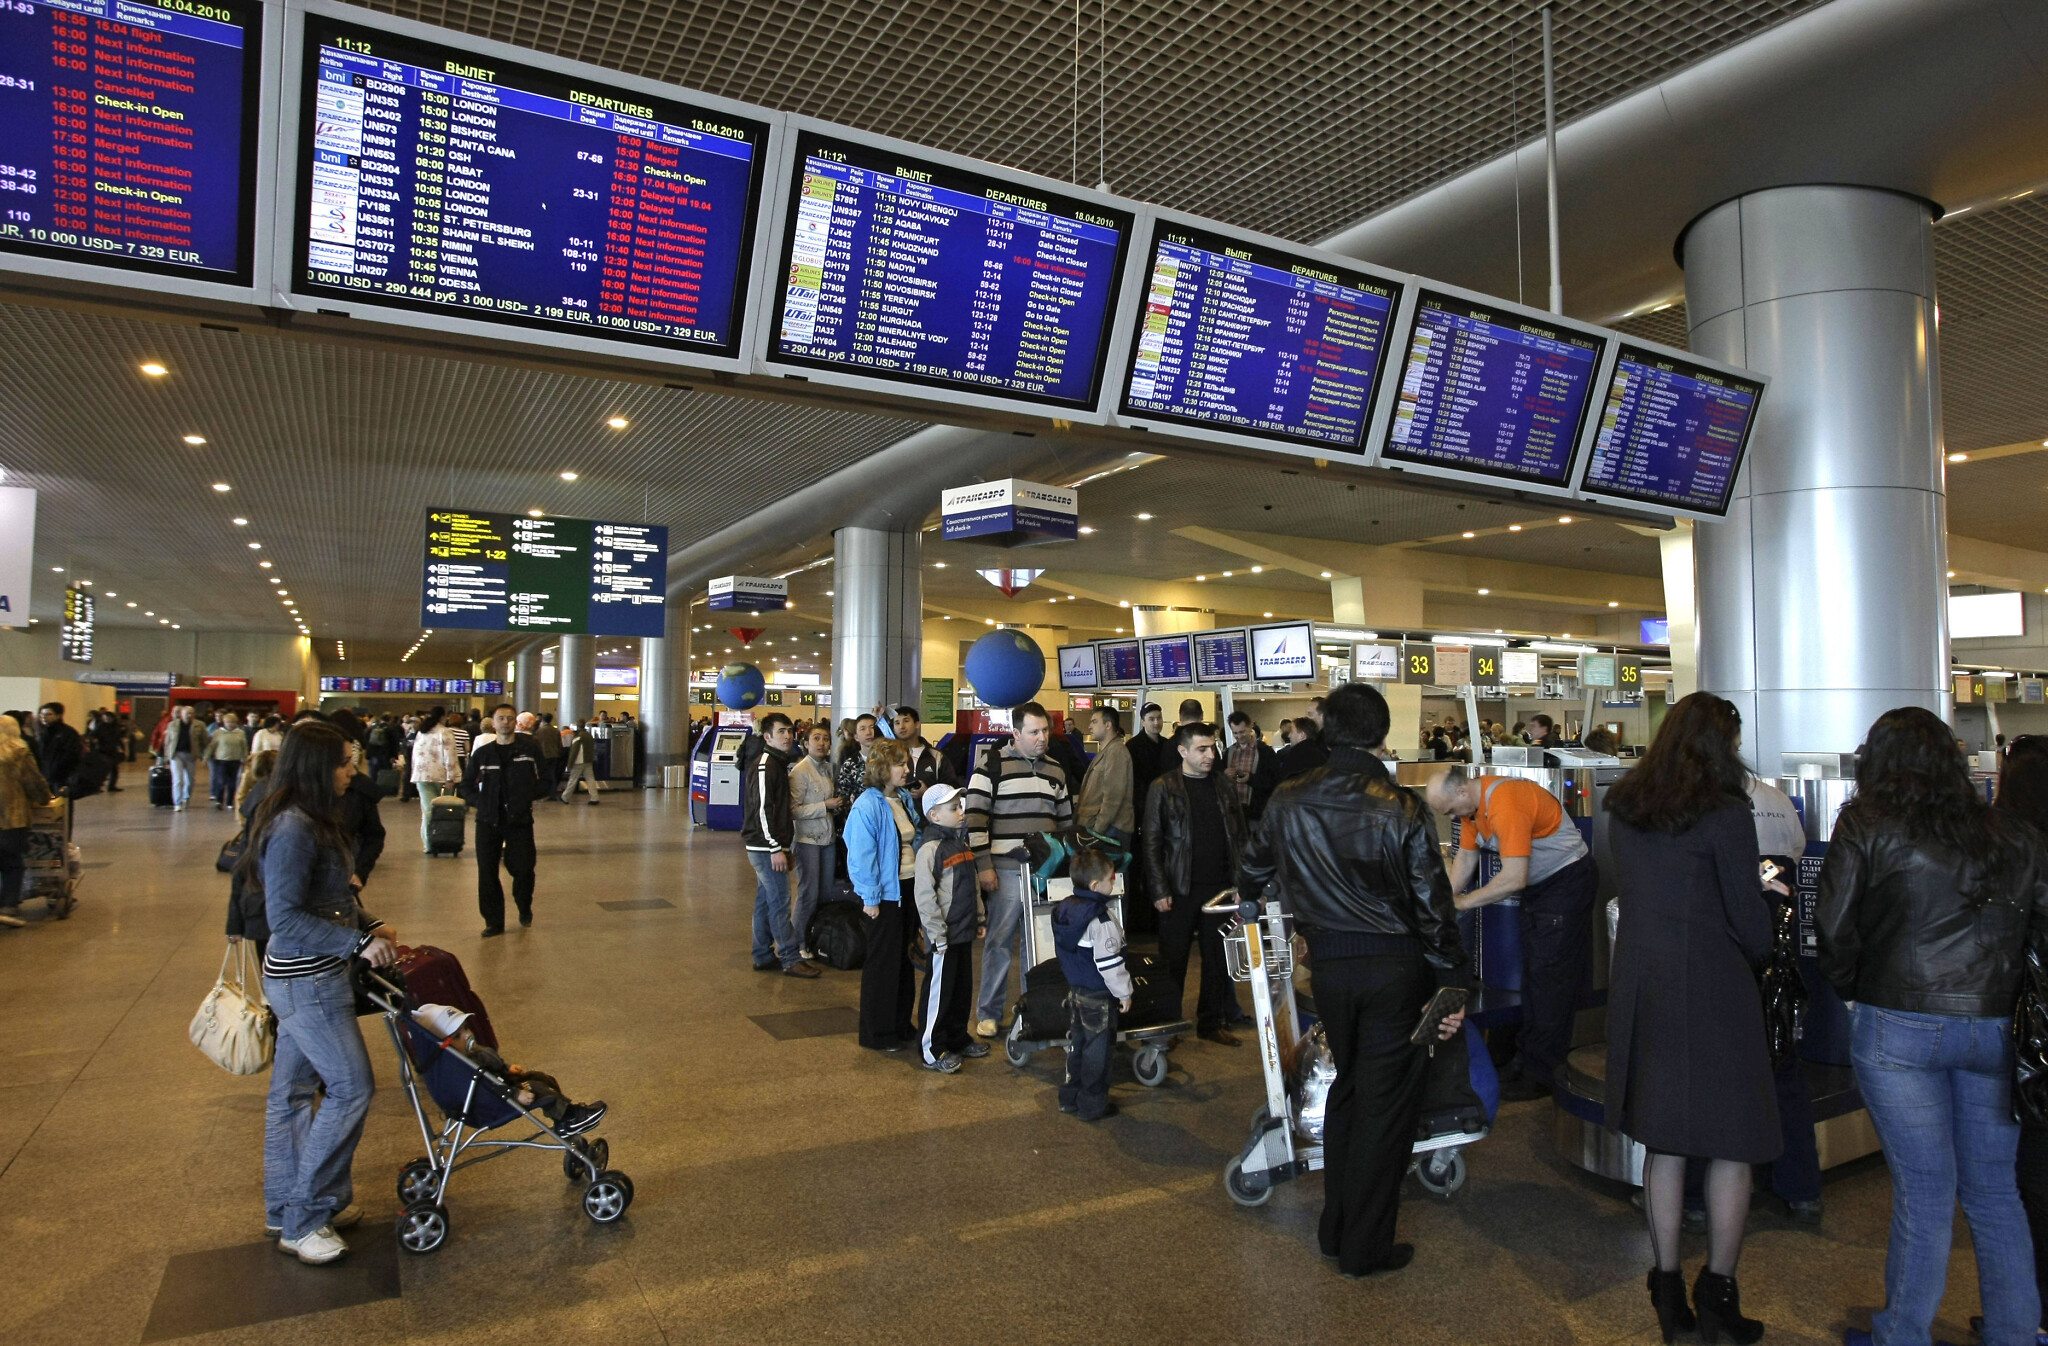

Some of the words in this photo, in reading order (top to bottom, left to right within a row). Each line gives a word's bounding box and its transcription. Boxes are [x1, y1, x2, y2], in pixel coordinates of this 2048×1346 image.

[51, 10, 87, 26] 16:55
[95, 19, 128, 35] 15.04
[131, 27, 162, 42] flight
[115, 11, 154, 26] Remarks
[52, 25, 87, 41] 16:00
[94, 34, 123, 49] Next
[125, 41, 195, 64] information
[335, 37, 371, 54] 11:12
[445, 60, 495, 82] ВЫЛЕТ
[93, 79, 155, 100] Cancelled
[52, 85, 87, 101] 13:00
[94, 94, 148, 113] Check-in
[151, 105, 183, 120] Open
[325, 69, 345, 82] bmi
[365, 78, 405, 95] BD2906
[421, 91, 449, 105] 15:00
[452, 97, 497, 115] LONDON
[617, 134, 641, 147] 15:00
[646, 140, 679, 155] Merged
[569, 89, 653, 118] DEPARTURES
[691, 119, 744, 139] 18.04.2010
[52, 129, 87, 144] 17:50
[94, 137, 140, 154] Merged
[362, 132, 395, 147] NN991
[416, 143, 445, 157] 01:20
[448, 150, 471, 163] OSH
[363, 119, 397, 134] UN573
[418, 130, 446, 144] 16:50
[449, 137, 485, 152] PUNTA
[486, 145, 515, 159] CANA
[419, 117, 447, 131] 15:30
[450, 124, 496, 142] BISHKEK
[576, 150, 603, 164] 67-68
[614, 158, 639, 171] 12:30
[643, 165, 681, 180] Check-in
[683, 173, 706, 185] Open
[817, 148, 842, 162] 11:12
[895, 166, 932, 183] ВЫЛЕТ
[0, 164, 36, 179] 38-42
[53, 173, 87, 188] 12:05
[94, 181, 147, 198] Check-in
[149, 190, 182, 204] Open
[359, 185, 400, 201] UN333A
[360, 159, 400, 175] BD2904
[415, 170, 443, 183] 10:05
[446, 175, 490, 192] LONDON
[609, 207, 633, 219] 16:00
[637, 213, 658, 224] Next
[659, 217, 707, 233] information
[7, 209, 30, 221] 110
[985, 188, 1047, 211] DEPARTURES
[1074, 211, 1113, 227] 18.04.2010
[358, 198, 390, 212] FV186
[412, 208, 440, 221] 10:15
[442, 214, 460, 225] ST.
[467, 218, 531, 237] PETERSBURG
[568, 236, 593, 248] 10-11
[875, 191, 896, 202] 11:15
[898, 196, 920, 208] NOVY
[921, 201, 958, 216] URENGOJ
[987, 217, 1014, 230] 112-119
[1039, 230, 1055, 239] Gate
[1056, 234, 1078, 245] Closed
[897, 207, 949, 226] VLADIKAVKAZ
[442, 227, 479, 241] SHARM
[481, 233, 495, 244] EL
[496, 236, 534, 250] SHEIKH
[561, 247, 597, 261] 108-110
[893, 229, 939, 245] FRANKFURT
[894, 218, 921, 231] AQABA
[1036, 250, 1064, 262] Check-in
[1065, 257, 1087, 268] Closed
[28, 228, 46, 240] 10
[49, 231, 77, 245] 000
[126, 242, 134, 253] 7
[139, 244, 164, 258] 329
[168, 249, 203, 264] EUR.
[891, 240, 939, 256] KHUDZHAND
[1224, 247, 1252, 261] ВЫЛЕТ
[440, 252, 478, 266] VIENNA
[889, 250, 927, 265] KOGALYM
[888, 261, 915, 273] NADYM
[1291, 264, 1337, 283] DEPARTURES
[438, 277, 480, 291] ODESSA
[561, 296, 587, 307] 38-40
[883, 293, 919, 307] YEREVAN
[886, 272, 937, 288] NOVOSIBIRSK
[1045, 304, 1060, 313] Gate
[1221, 291, 1256, 304] КРАСНОДАР
[385, 281, 407, 294] 290
[409, 286, 431, 297] 444
[533, 304, 541, 314] 2
[544, 306, 563, 317] 199
[664, 324, 670, 334] 7
[672, 326, 691, 337] 329
[881, 304, 913, 316] SURGUT
[879, 314, 922, 329] HURGHADA
[877, 325, 926, 340] MINERALNYE
[927, 333, 948, 343] VODY
[1519, 324, 1555, 339] DEPARTURES
[876, 335, 917, 349] SALEHARD
[874, 345, 915, 359] TASHKENT
[946, 525, 954, 533] Self
[485, 549, 507, 560] 1-22
[1260, 656, 1306, 665] TRANSAERO
[1410, 655, 1429, 674] 33
[1477, 657, 1494, 676] 34
[1621, 666, 1637, 682] 35
[702, 692, 712, 700] 12
[770, 693, 779, 701] 13
[803, 694, 812, 702] 14
[1974, 683, 1984, 696] 40
